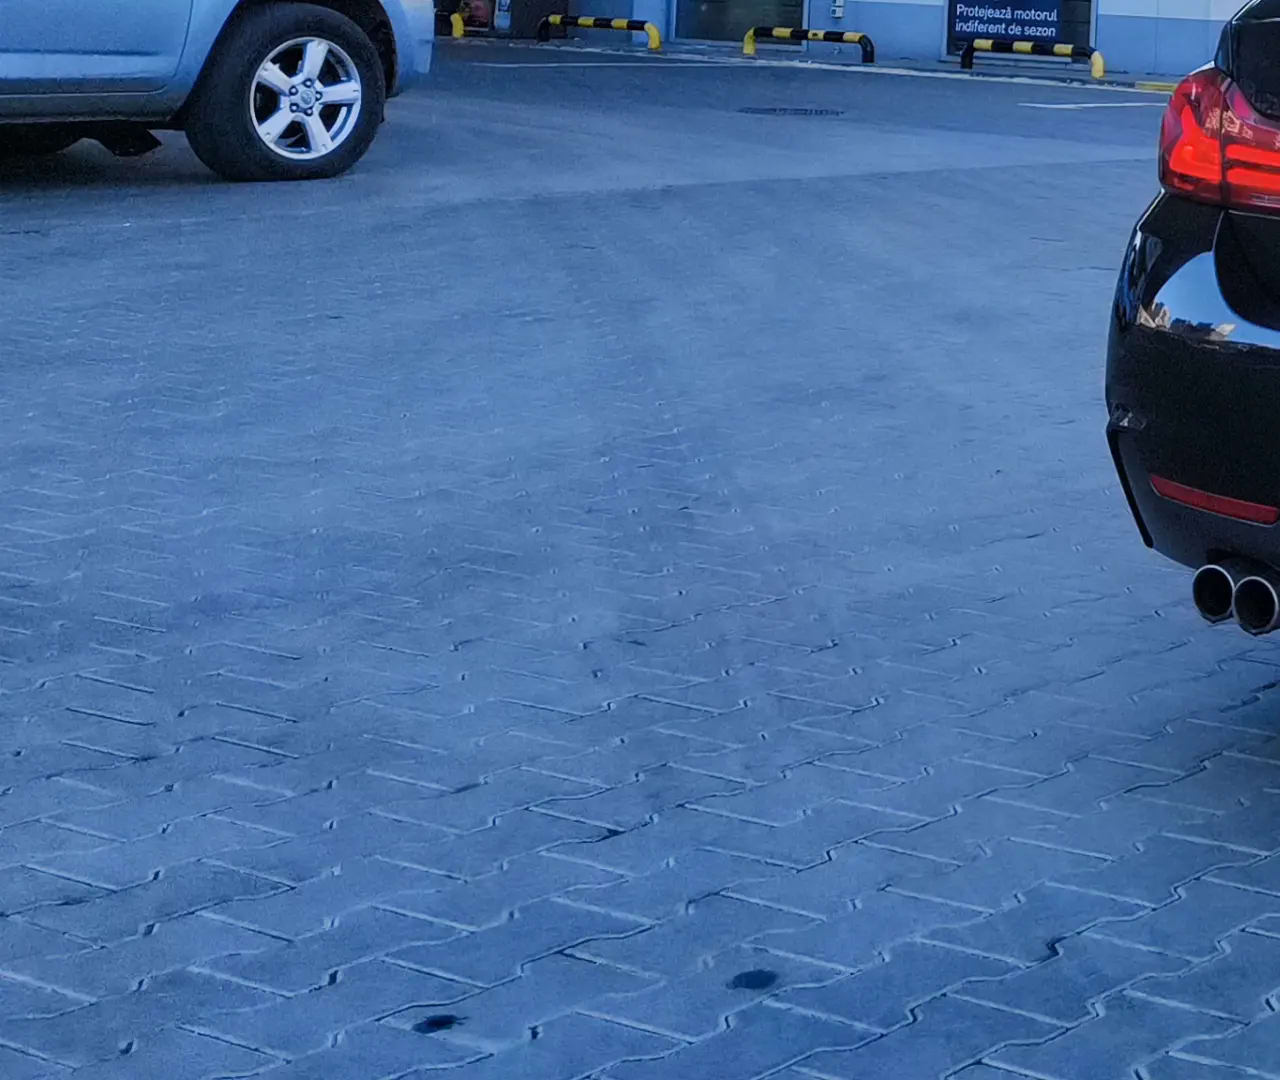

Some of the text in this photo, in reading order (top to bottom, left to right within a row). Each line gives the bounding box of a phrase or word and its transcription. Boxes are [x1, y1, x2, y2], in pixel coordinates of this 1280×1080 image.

[1013, 9, 1058, 22] motorul
[955, 19, 1056, 37] indiferent de sezon
